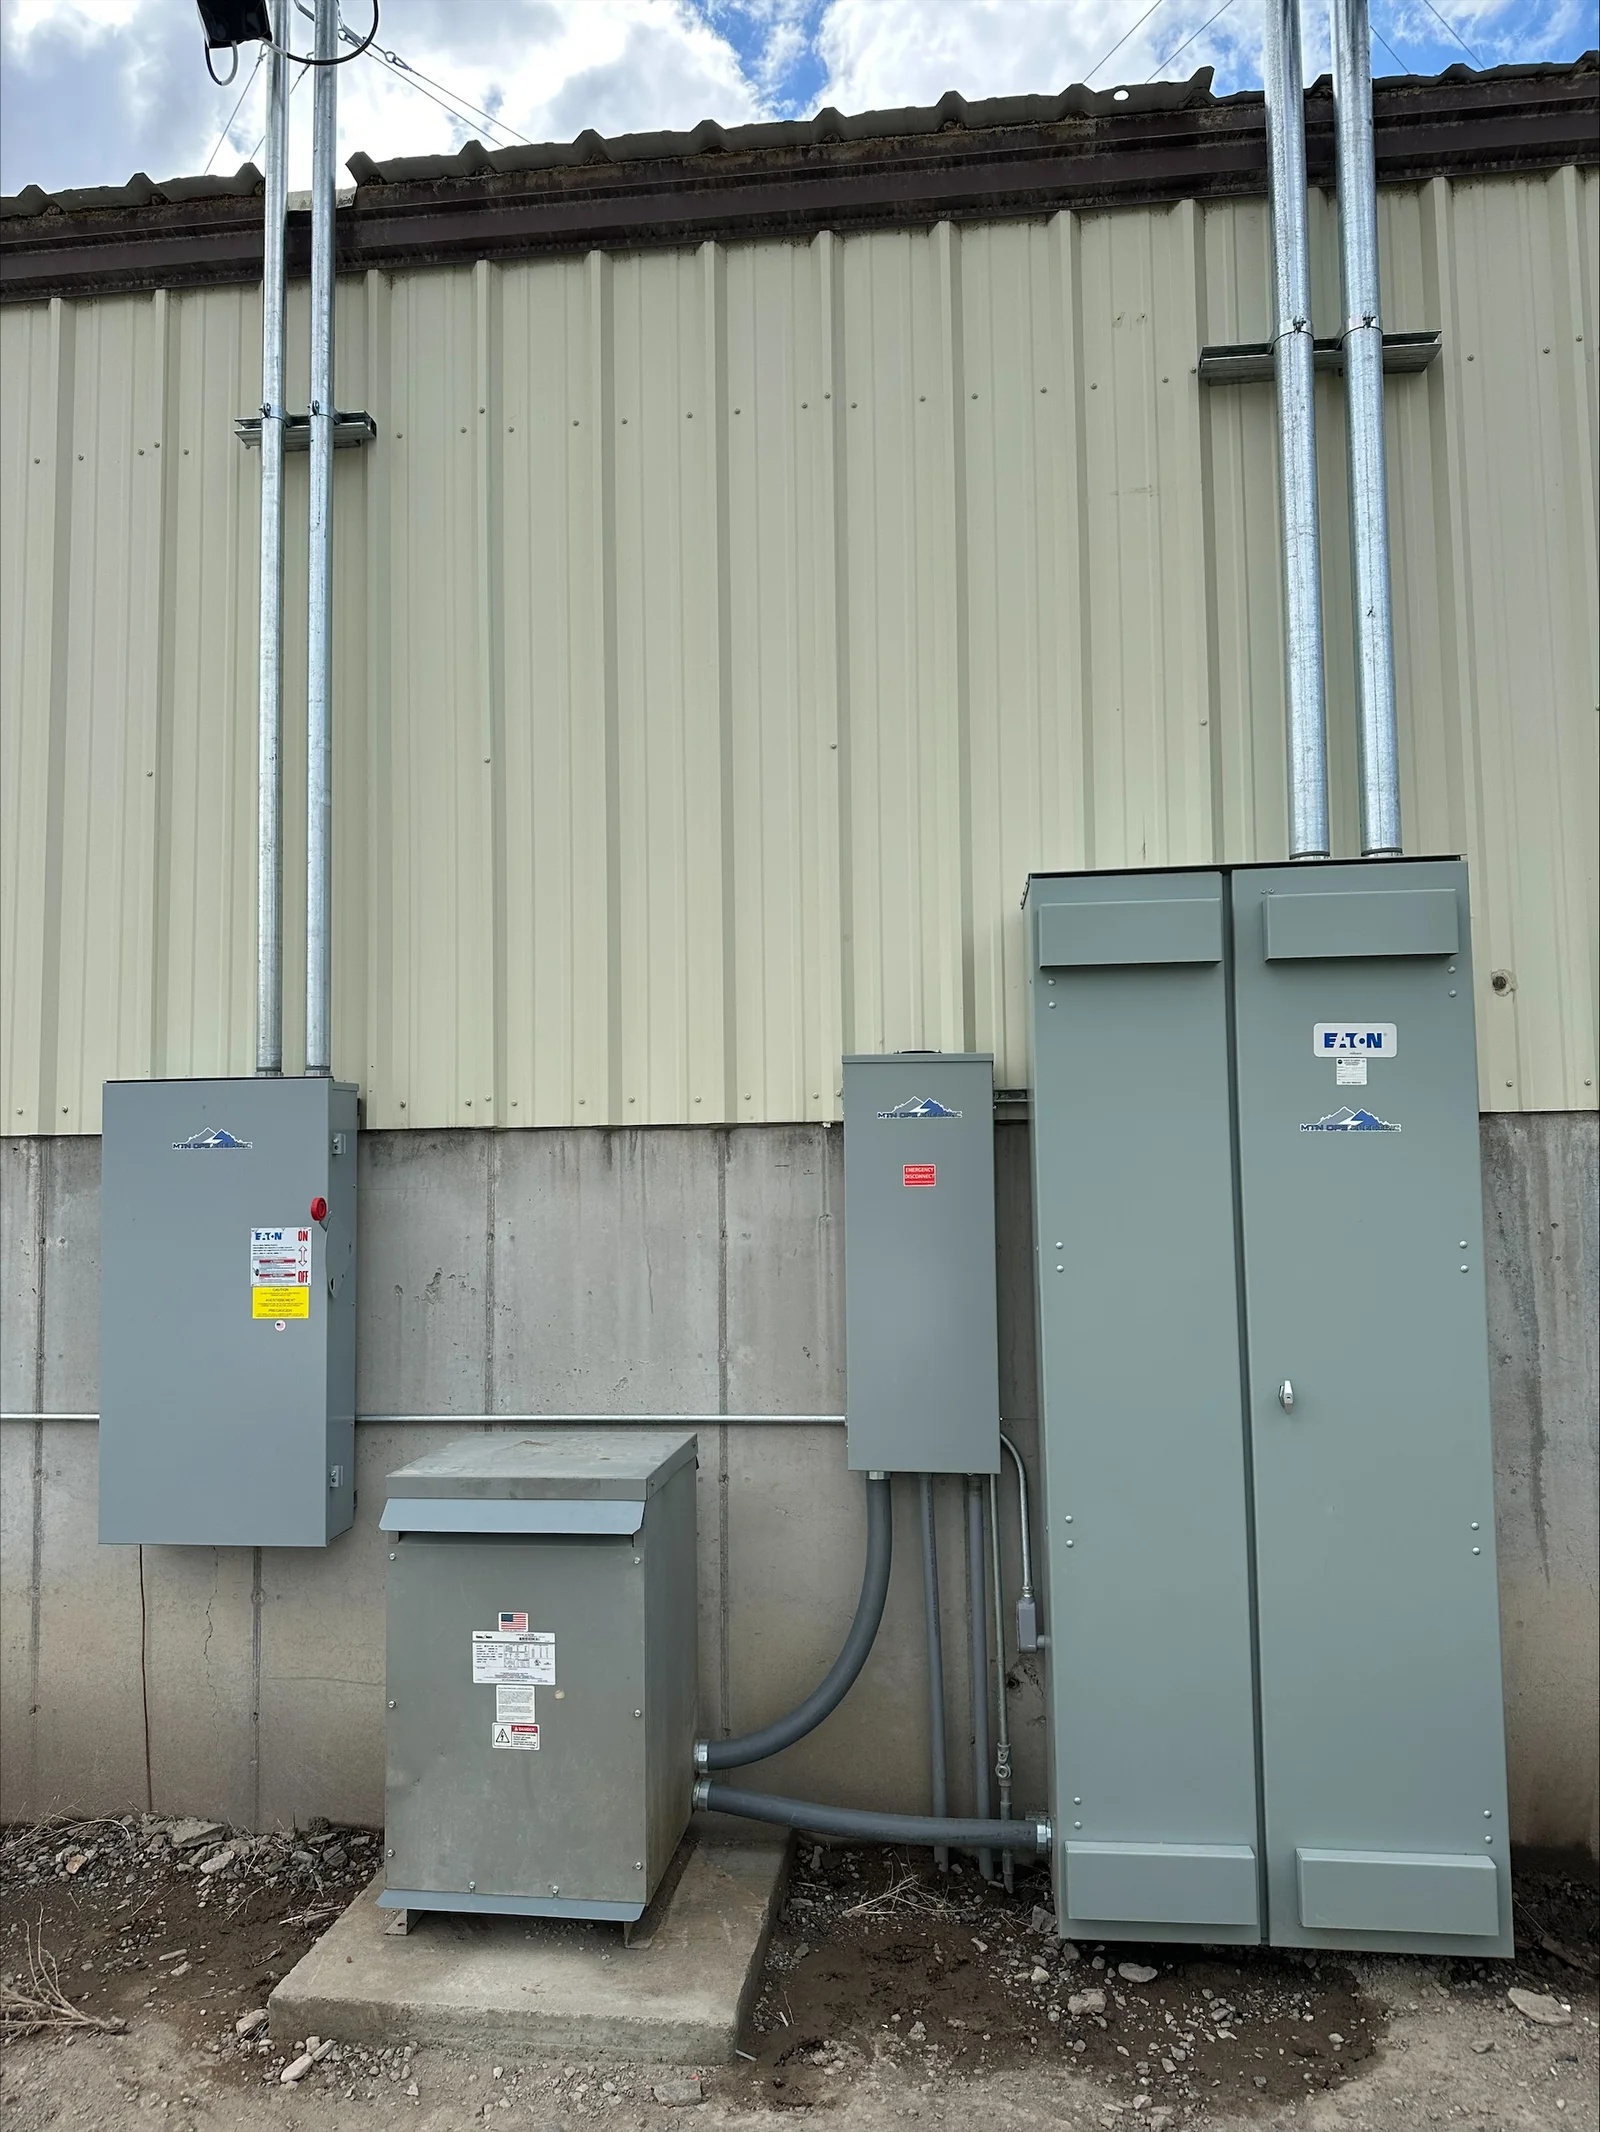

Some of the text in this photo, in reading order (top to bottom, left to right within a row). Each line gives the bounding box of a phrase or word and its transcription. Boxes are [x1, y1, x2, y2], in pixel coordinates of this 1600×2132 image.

[1324, 1033, 1382, 1048] EATON
[255, 1232, 282, 1240] EATON
[298, 1230, 308, 1241] ON
[298, 1271, 308, 1283] OFF
